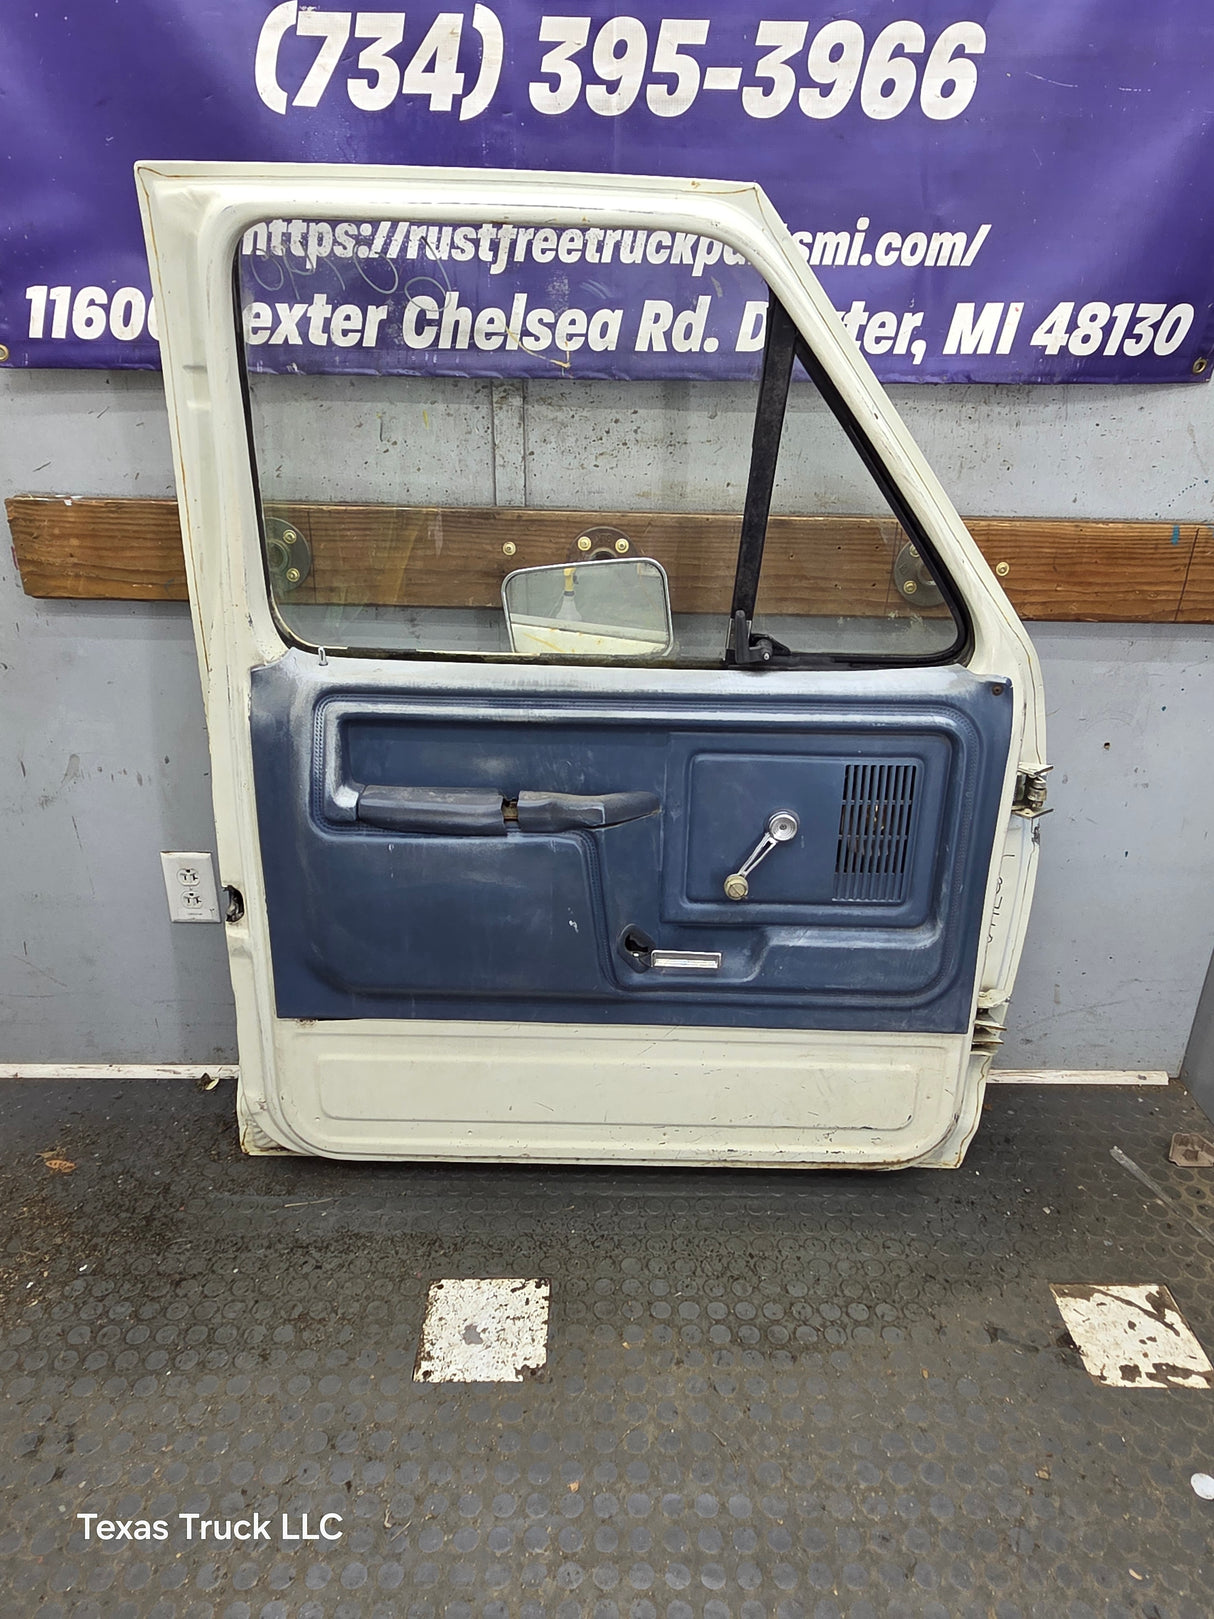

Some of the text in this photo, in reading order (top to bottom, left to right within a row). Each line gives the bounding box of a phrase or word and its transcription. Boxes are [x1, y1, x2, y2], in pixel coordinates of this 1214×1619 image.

[254, 1, 986, 121] (734) 395-3966
[242, 293, 388, 348] exter
[402, 291, 623, 352] Chelsea
[634, 295, 720, 353] Rd.
[735, 300, 925, 365] Dter,
[942, 302, 1025, 356] MI
[1029, 302, 1195, 357] 48130
